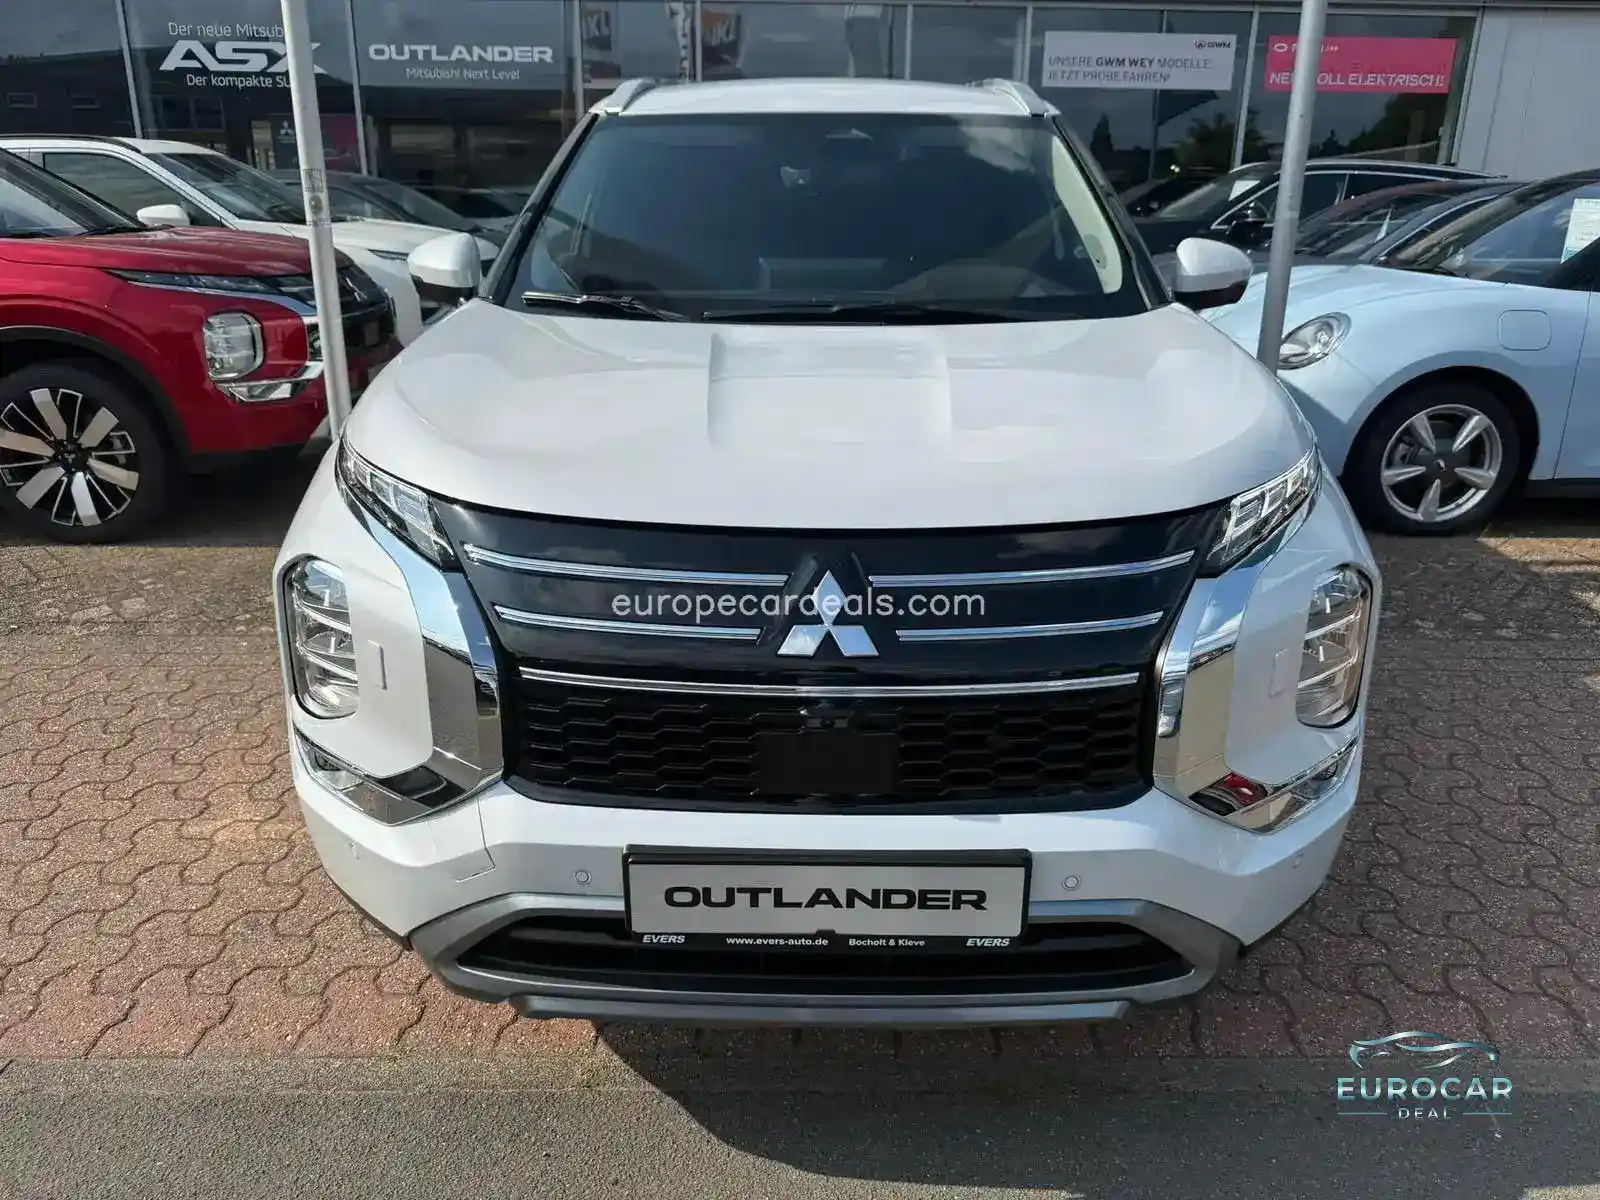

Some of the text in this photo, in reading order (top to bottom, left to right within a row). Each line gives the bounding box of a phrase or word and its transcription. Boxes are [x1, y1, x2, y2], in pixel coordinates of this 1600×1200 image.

[168, 22, 284, 38] Der neue Mitsub
[368, 44, 554, 63] OUTLANDER
[1048, 56, 1093, 67] UNSERE
[1095, 56, 1125, 67] GWM
[1128, 57, 1155, 68] WEY
[406, 68, 520, 80] Mitsubishi Next Level
[1048, 70, 1080, 80] JETZT
[1316, 73, 1345, 85] OLL
[1348, 73, 1445, 87] ELEKTRISCH!
[187, 74, 207, 86] Der
[211, 75, 272, 89] kompakte
[664, 886, 988, 911] OUTLANDER
[642, 934, 685, 944] EVERS
[725, 937, 829, 946] www.evers-auto.de
[849, 938, 925, 947] Bocholt & Kleve
[966, 938, 1010, 947] EVERS
